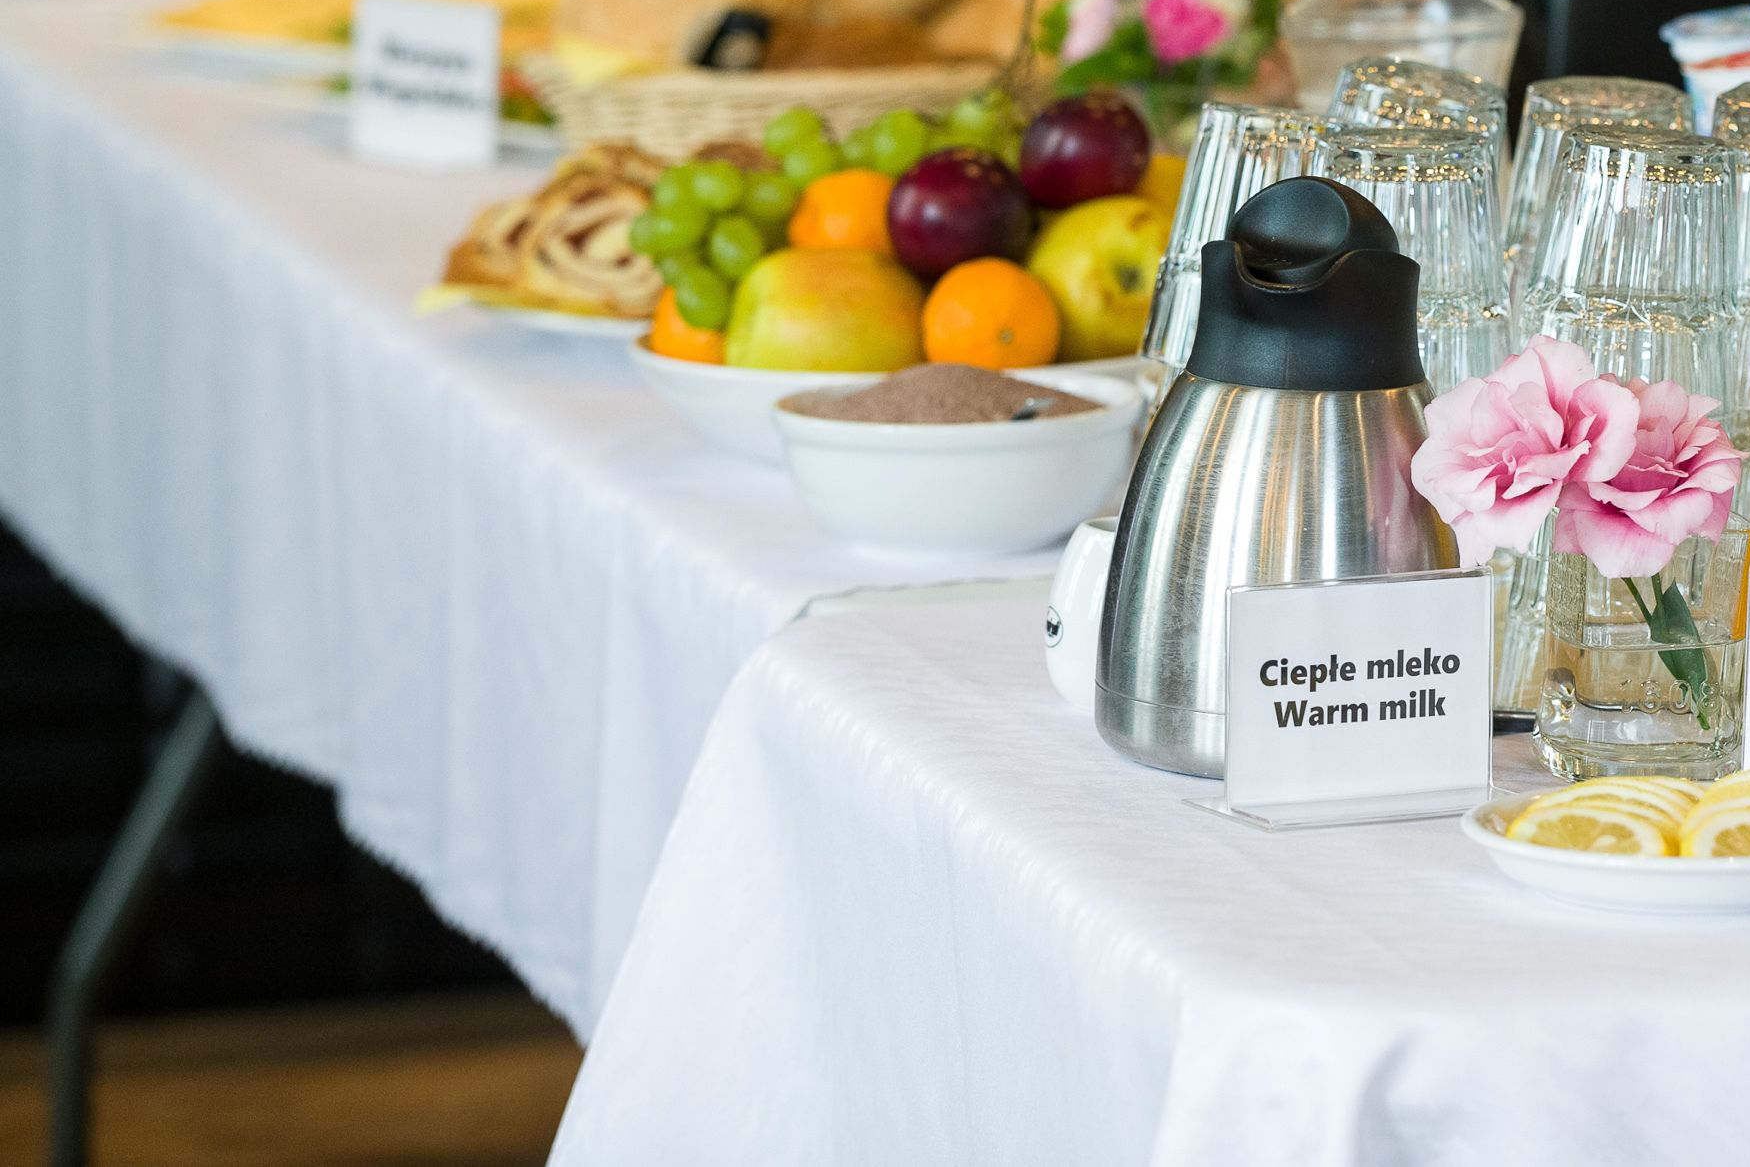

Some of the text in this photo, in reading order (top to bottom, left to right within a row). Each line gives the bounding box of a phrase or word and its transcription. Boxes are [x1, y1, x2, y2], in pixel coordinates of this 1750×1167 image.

[1259, 647, 1461, 692] Ciepłe mleko
[1274, 689, 1446, 728] Warm milk
